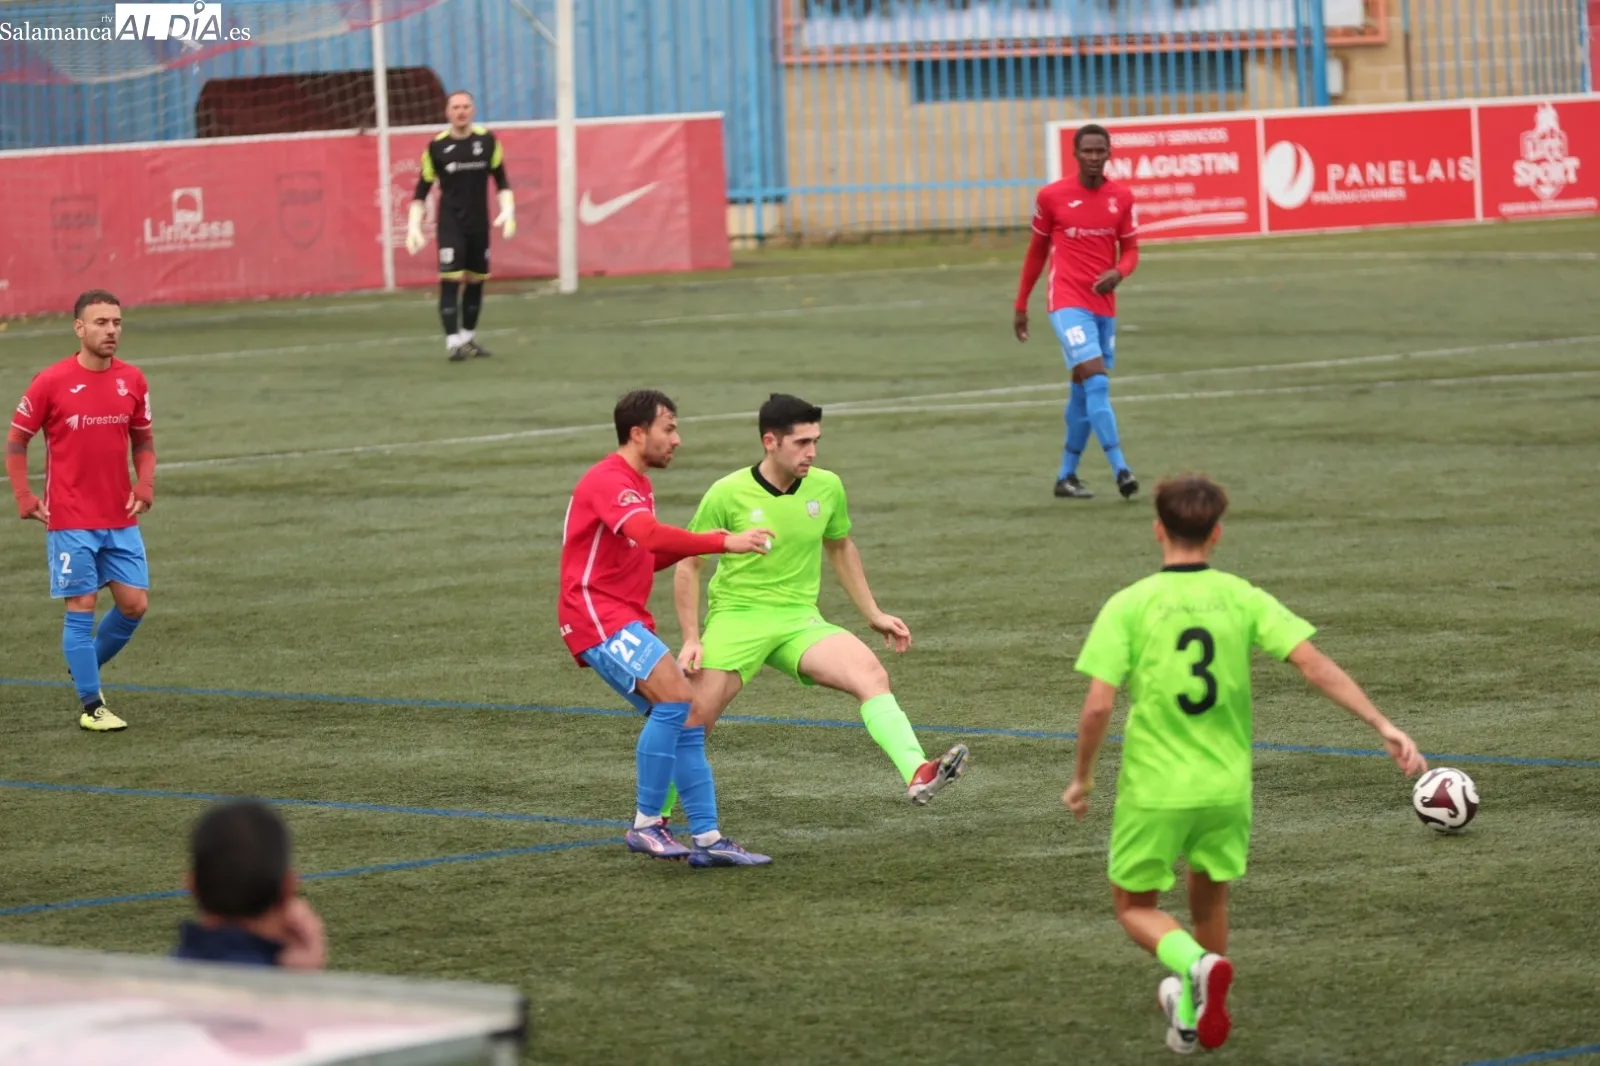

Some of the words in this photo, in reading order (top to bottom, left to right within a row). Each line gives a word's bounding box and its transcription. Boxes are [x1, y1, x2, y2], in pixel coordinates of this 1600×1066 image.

[1166, 127, 1229, 146] SERVICIOS
[1103, 157, 1133, 181] AN
[1135, 151, 1240, 180] AGUSTIN
[1326, 155, 1475, 195] PANELAIS
[1512, 156, 1581, 188] SPORT
[1065, 325, 1087, 347] 15
[59, 552, 73, 574] 2
[609, 628, 642, 664] 21
[1175, 626, 1218, 716] 3
